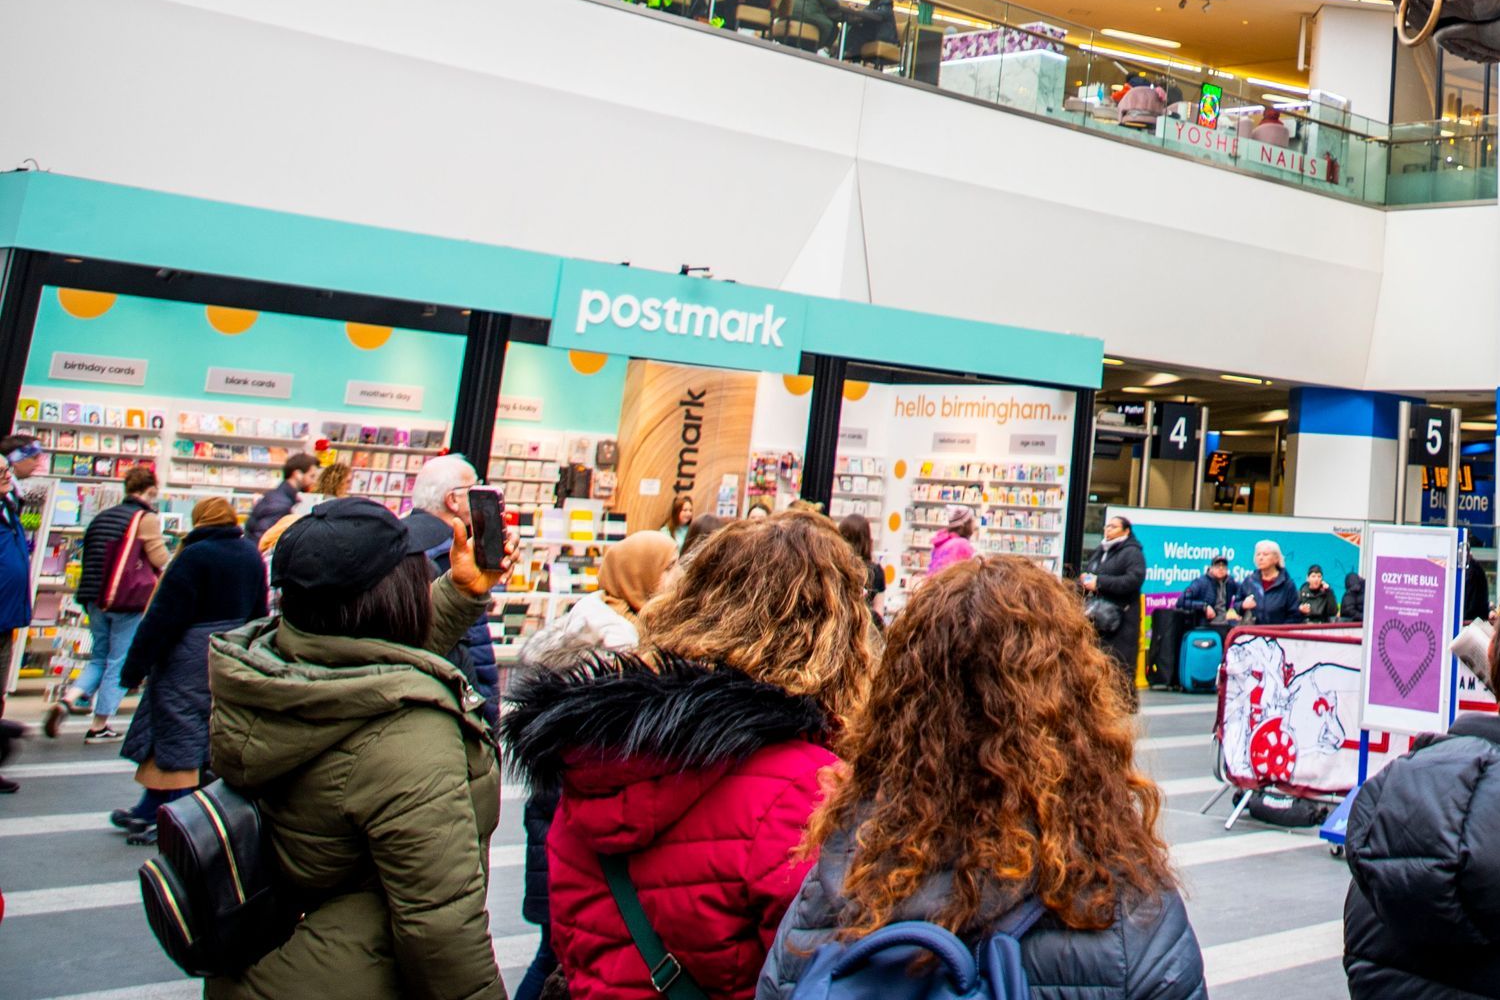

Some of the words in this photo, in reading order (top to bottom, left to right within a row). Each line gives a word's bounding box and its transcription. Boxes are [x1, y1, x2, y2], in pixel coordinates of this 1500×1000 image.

[1260, 144, 1317, 176] NAILS
[575, 288, 786, 347] postmark
[63, 360, 107, 375] birthday
[108, 365, 136, 376] cards
[225, 375, 250, 386] blank
[251, 378, 276, 389] cards
[396, 391, 412, 402] day
[894, 395, 936, 418] hello
[673, 388, 707, 495] tmark
[1169, 416, 1188, 450] 4
[1426, 418, 1442, 455] 5
[1458, 494, 1489, 512] zone
[1164, 541, 1219, 560] Welcome
[1221, 545, 1235, 561] to
[1382, 572, 1402, 584] OZZY
[1403, 574, 1419, 586] THE
[1420, 575, 1439, 587] BULL
[1146, 596, 1167, 607] Thank
